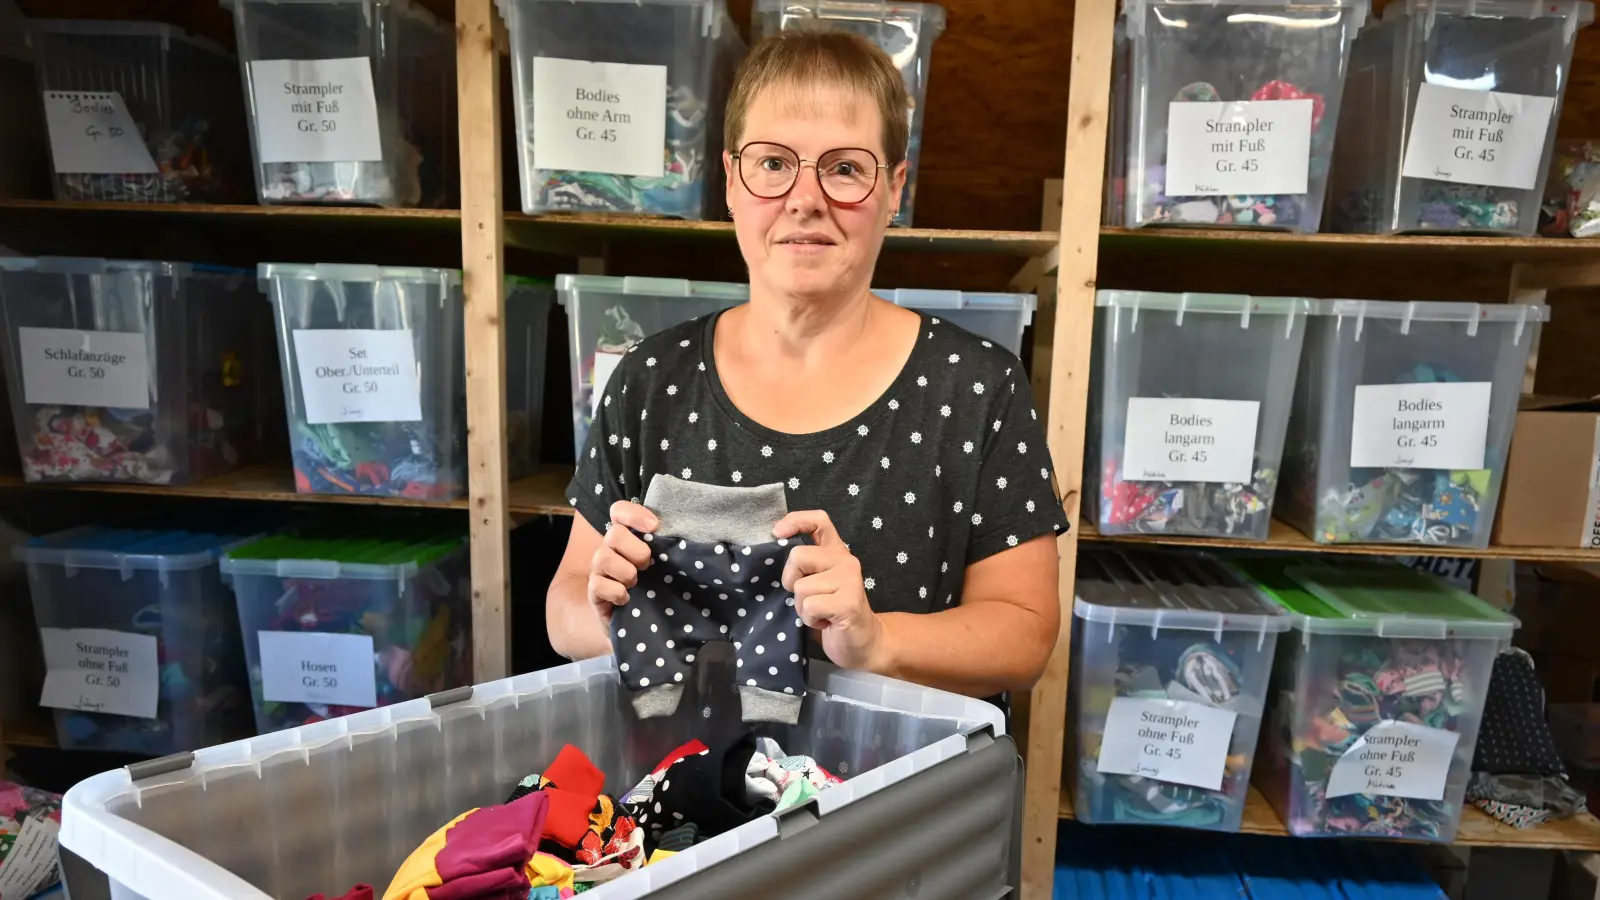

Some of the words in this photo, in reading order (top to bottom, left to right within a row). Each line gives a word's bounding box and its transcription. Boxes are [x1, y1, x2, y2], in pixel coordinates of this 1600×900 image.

[283, 82, 344, 97] Strampler
[576, 87, 620, 103] Bodies
[291, 101, 312, 113] mit
[316, 100, 339, 113] Fuß
[566, 106, 599, 121] ohne
[602, 109, 631, 123] Arm
[1450, 104, 1514, 125] Strampler
[297, 120, 317, 132] Gr.
[321, 120, 336, 132] 50
[1205, 118, 1274, 135] Strampler
[576, 127, 595, 140] Gr.
[600, 129, 617, 142] 45
[1452, 127, 1474, 140] mit
[1479, 128, 1504, 143] Fuß
[1211, 141, 1234, 152] mit
[1239, 138, 1265, 152] Fuß
[1454, 145, 1474, 160] Gr.
[1479, 149, 1495, 162] 45
[1216, 160, 1236, 172] Gr.
[1241, 159, 1258, 172] 45
[44, 348, 126, 366] Schlafanzüge
[348, 347, 367, 359] Set
[67, 366, 86, 378] Gr.
[89, 367, 105, 379] 50
[342, 382, 361, 394] Gr.
[364, 381, 378, 393] 50
[1398, 398, 1443, 411] Bodies
[1170, 413, 1213, 426] Bodies
[1393, 417, 1445, 432] langarm
[1164, 431, 1215, 447] langarm
[1397, 436, 1416, 447] Gr.
[1420, 435, 1437, 447] 45
[1168, 450, 1187, 462] Gr.
[1191, 450, 1207, 463] 45
[76, 642, 129, 658] Strampler
[78, 658, 105, 670] ohne
[108, 661, 128, 673] Fuß
[301, 661, 337, 672] Hosen
[85, 673, 103, 685] Gr.
[106, 676, 120, 687] 50
[302, 677, 319, 687] Gr.
[323, 677, 337, 688] 50
[1140, 711, 1200, 728] Strampler
[1138, 728, 1167, 740] ohne
[1171, 731, 1195, 745] Fuß
[1364, 734, 1421, 748] Strampler
[1144, 744, 1161, 757] Gr.
[1166, 748, 1181, 760] 45
[1360, 750, 1387, 761] ohne
[1391, 750, 1415, 762] Fuß
[1364, 766, 1381, 776] Gr.
[1386, 766, 1402, 777] 45
